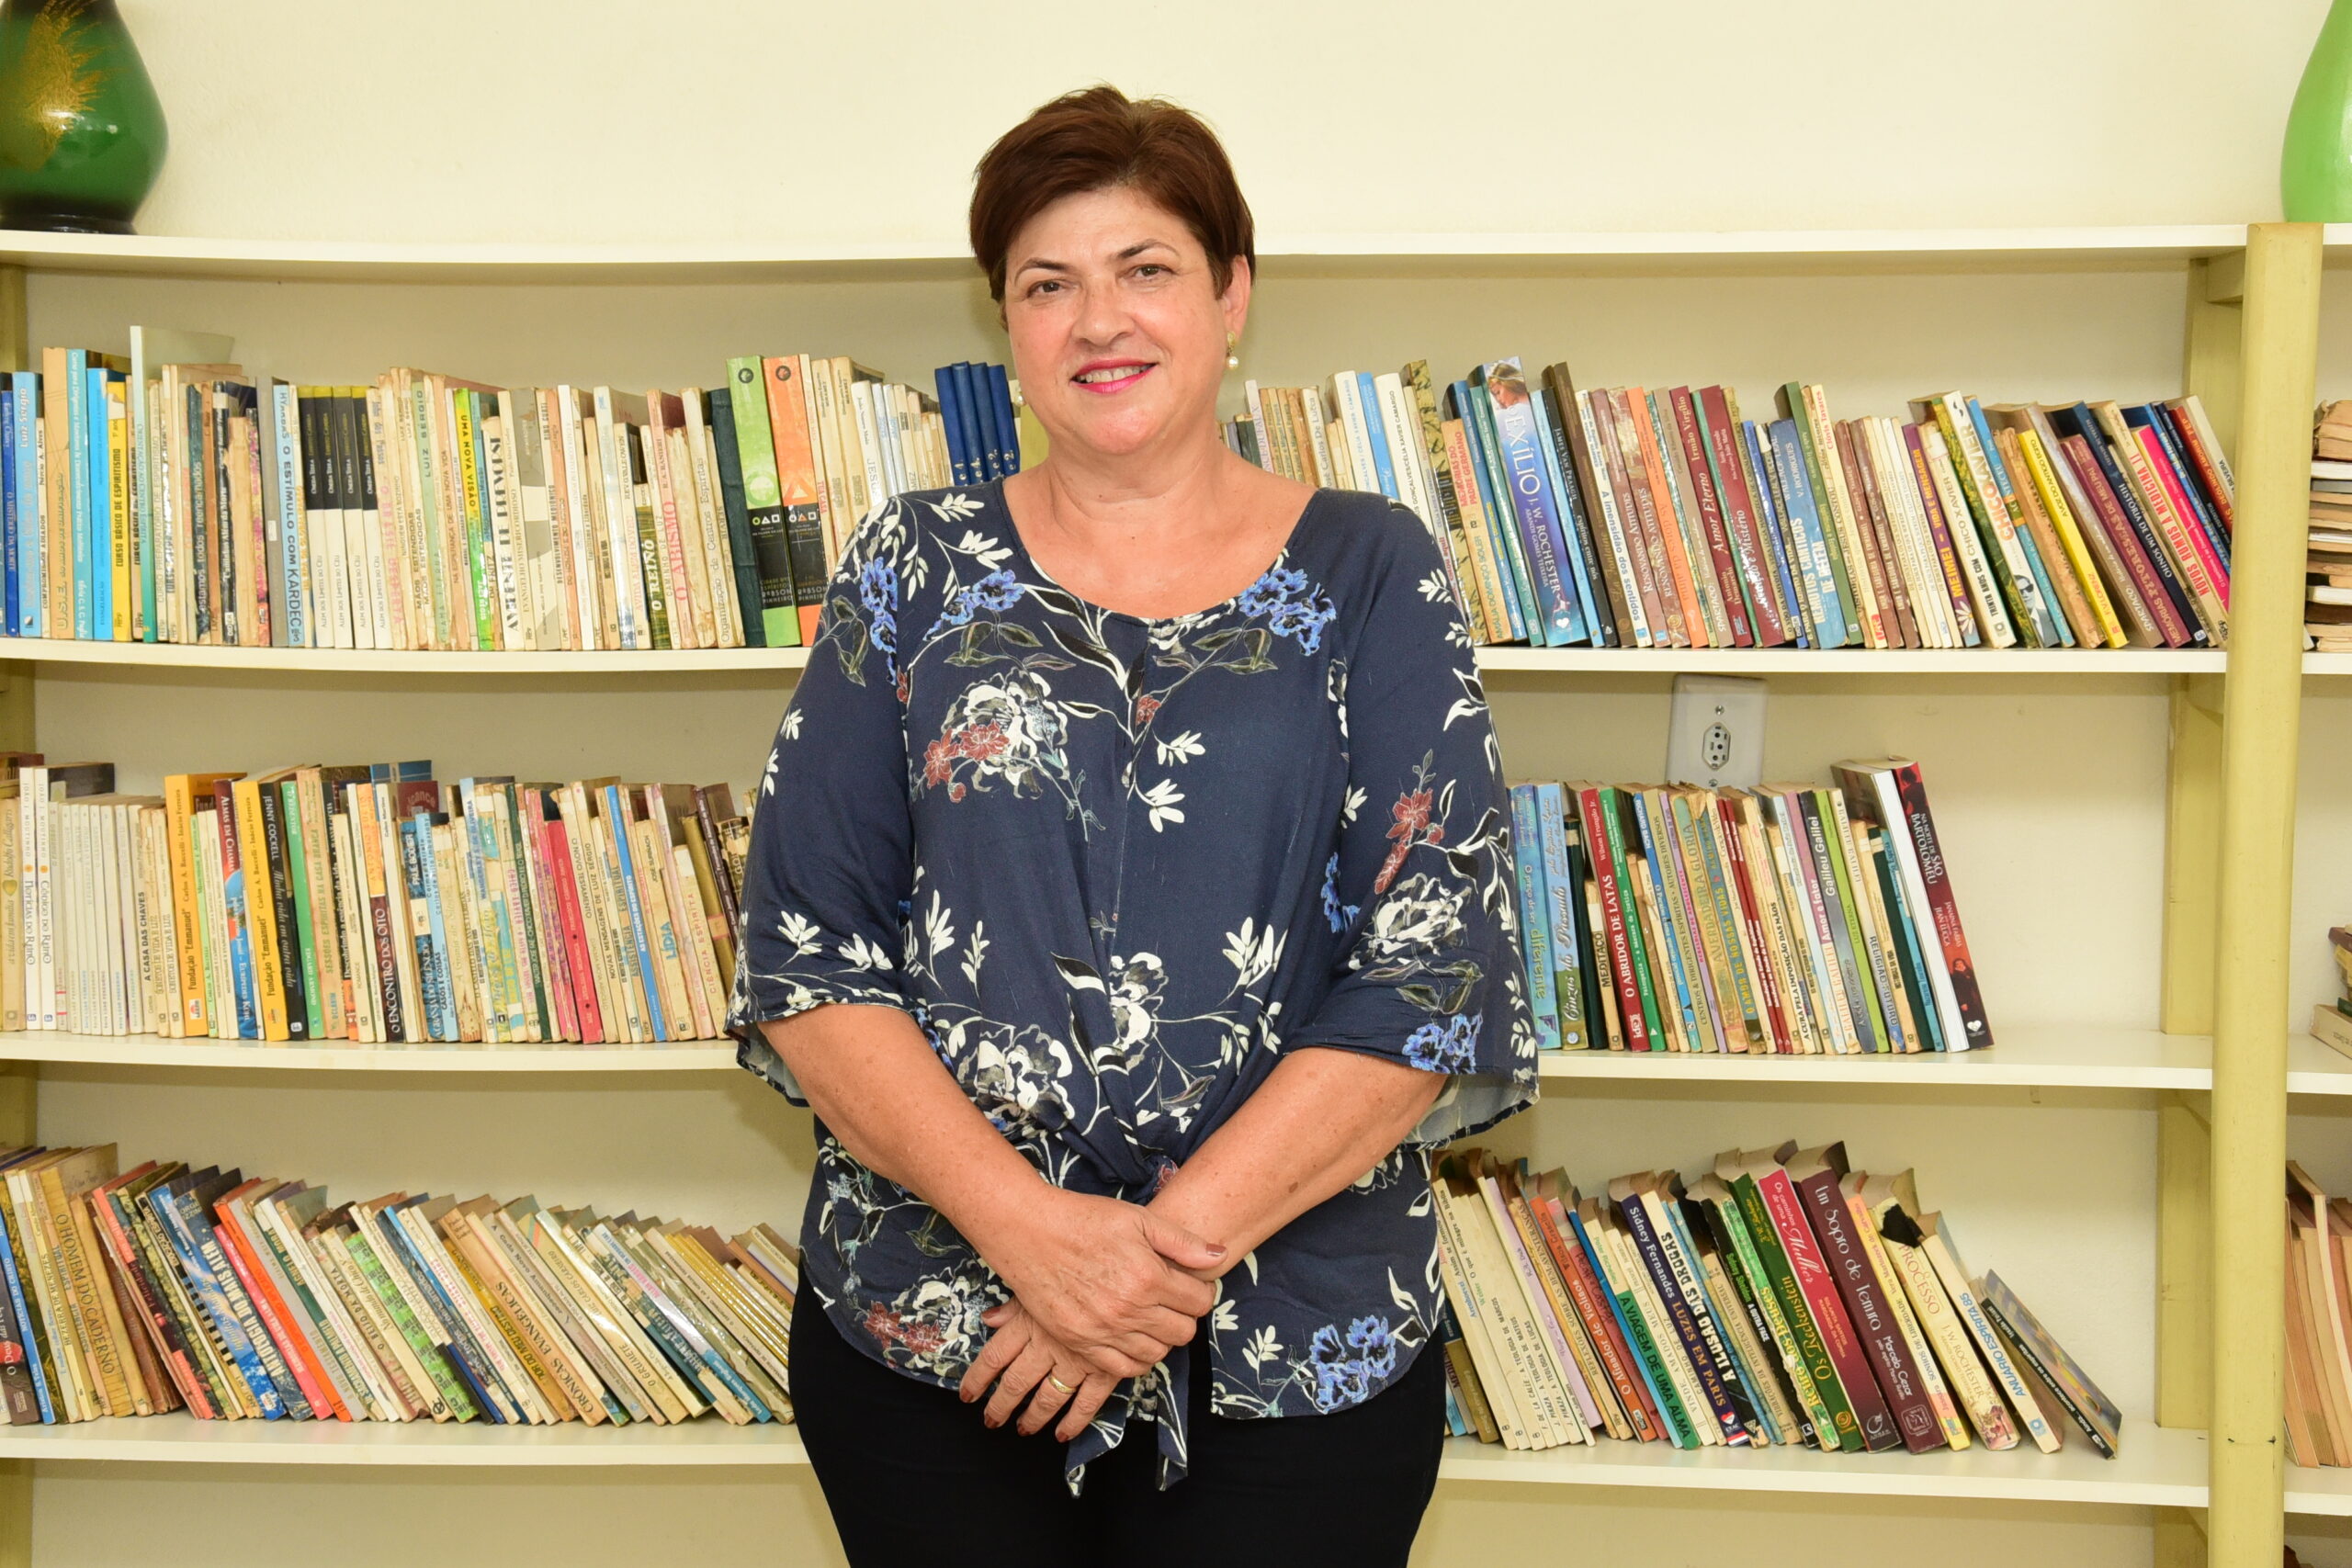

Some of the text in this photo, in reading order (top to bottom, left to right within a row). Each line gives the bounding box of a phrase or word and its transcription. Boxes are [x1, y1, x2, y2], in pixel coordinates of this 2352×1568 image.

[283, 446, 290, 454] O
[415, 389, 432, 478] LUIZ SÉRGIO
[1677, 396, 1701, 461] Irmão Virgílio
[459, 414, 477, 507] UMA NOVA VISÃO
[1449, 446, 1469, 507] MEMÓRIAS DO
[1455, 431, 1478, 505] PADRE GERMANO
[1502, 413, 1541, 495] EXÍLIO
[1912, 448, 1934, 498] MENSAGEM
[112, 448, 124, 567] CURSO BÁSICO DE ESPIRITISMO
[283, 461, 295, 529] ESTÍMULO
[1698, 472, 1728, 554] Amor Eterno
[2135, 466, 2168, 514] MEDICINA
[191, 461, 208, 612] estamos todos reencarnados
[1928, 507, 1942, 528] VIDA
[288, 535, 297, 565] COM
[662, 501, 688, 601] O ABISMO
[695, 457, 730, 643] Organização de Centros Espíritas
[1530, 497, 1562, 594] J. W. ROCHESTER
[1971, 558, 1983, 571] COM
[2170, 525, 2192, 561] RUMOS
[288, 568, 301, 626] KARDEC
[644, 539, 662, 611] O REINO
[1479, 564, 1496, 607] DOMINGO
[1720, 571, 1735, 603] Antonio
[1726, 566, 1741, 604] Demarchi
[1942, 547, 1964, 598] MEIMEI
[1974, 573, 1989, 592] ANOS
[2190, 562, 2211, 596] NOVOS
[1487, 608, 1504, 639] AMÁLIA
[1981, 594, 1999, 617] TRINTA
[173, 789, 183, 816] Ferreira
[262, 795, 279, 861] JENNY COCKELL
[1597, 838, 1606, 861] Wilson
[1807, 816, 1836, 897] Galileu Galilei
[180, 880, 189, 902] Carlos
[573, 847, 583, 871] NOVO
[578, 873, 592, 919] TESTAMENTO
[1601, 874, 1619, 913] LATAS
[1810, 878, 1822, 905] fator
[138, 892, 147, 927] CHAVES
[1611, 915, 1622, 930] DE
[1770, 902, 1784, 926] MÃOS
[1817, 913, 1831, 941] Amor
[141, 930, 149, 946] DAS
[660, 921, 678, 960] LÍDIA
[1552, 886, 1579, 1021] Cinzas do Passado
[1612, 931, 1634, 986] ABRIDOR
[1776, 927, 1786, 942] DAS
[142, 949, 151, 973] CASA
[185, 954, 198, 990] Fundação
[374, 908, 401, 1033] O ENCONTRO DOS OITO
[1530, 929, 1545, 999] diferente
[1780, 942, 1799, 988] IMPOSIÇÃO
[1625, 988, 1634, 998] O
[1793, 988, 1804, 1009] PELA
[1797, 1010, 1808, 1033] CURA
[56, 1213, 70, 1226] O
[4, 1258, 17, 1284] CRISTO
[62, 1229, 85, 1282] HOMEM
[1628, 1205, 1676, 1299] Sidney Fernandes
[1814, 1185, 1882, 1330] Um Sopro de Ternura
[11, 1285, 20, 1296] DO
[76, 1286, 93, 1305] DO
[199, 1238, 285, 1378] ANTOLOGIA DO MAIS ALÉM
[1660, 1231, 1736, 1380] A ILUSÃO DAS DROGAS
[1573, 1279, 1632, 1394] O Afinador de Violinos
[1781, 1275, 1833, 1380] Os Reckenstein
[1959, 1292, 2026, 1397] ANUÁRIO ESPÍRITA 85
[1619, 1296, 1691, 1438] A VIAGEM DE UMA ALMA
[1672, 1301, 1726, 1406] LUZES EM PARIS
[1883, 1336, 1915, 1396] Marcelo Cezar
